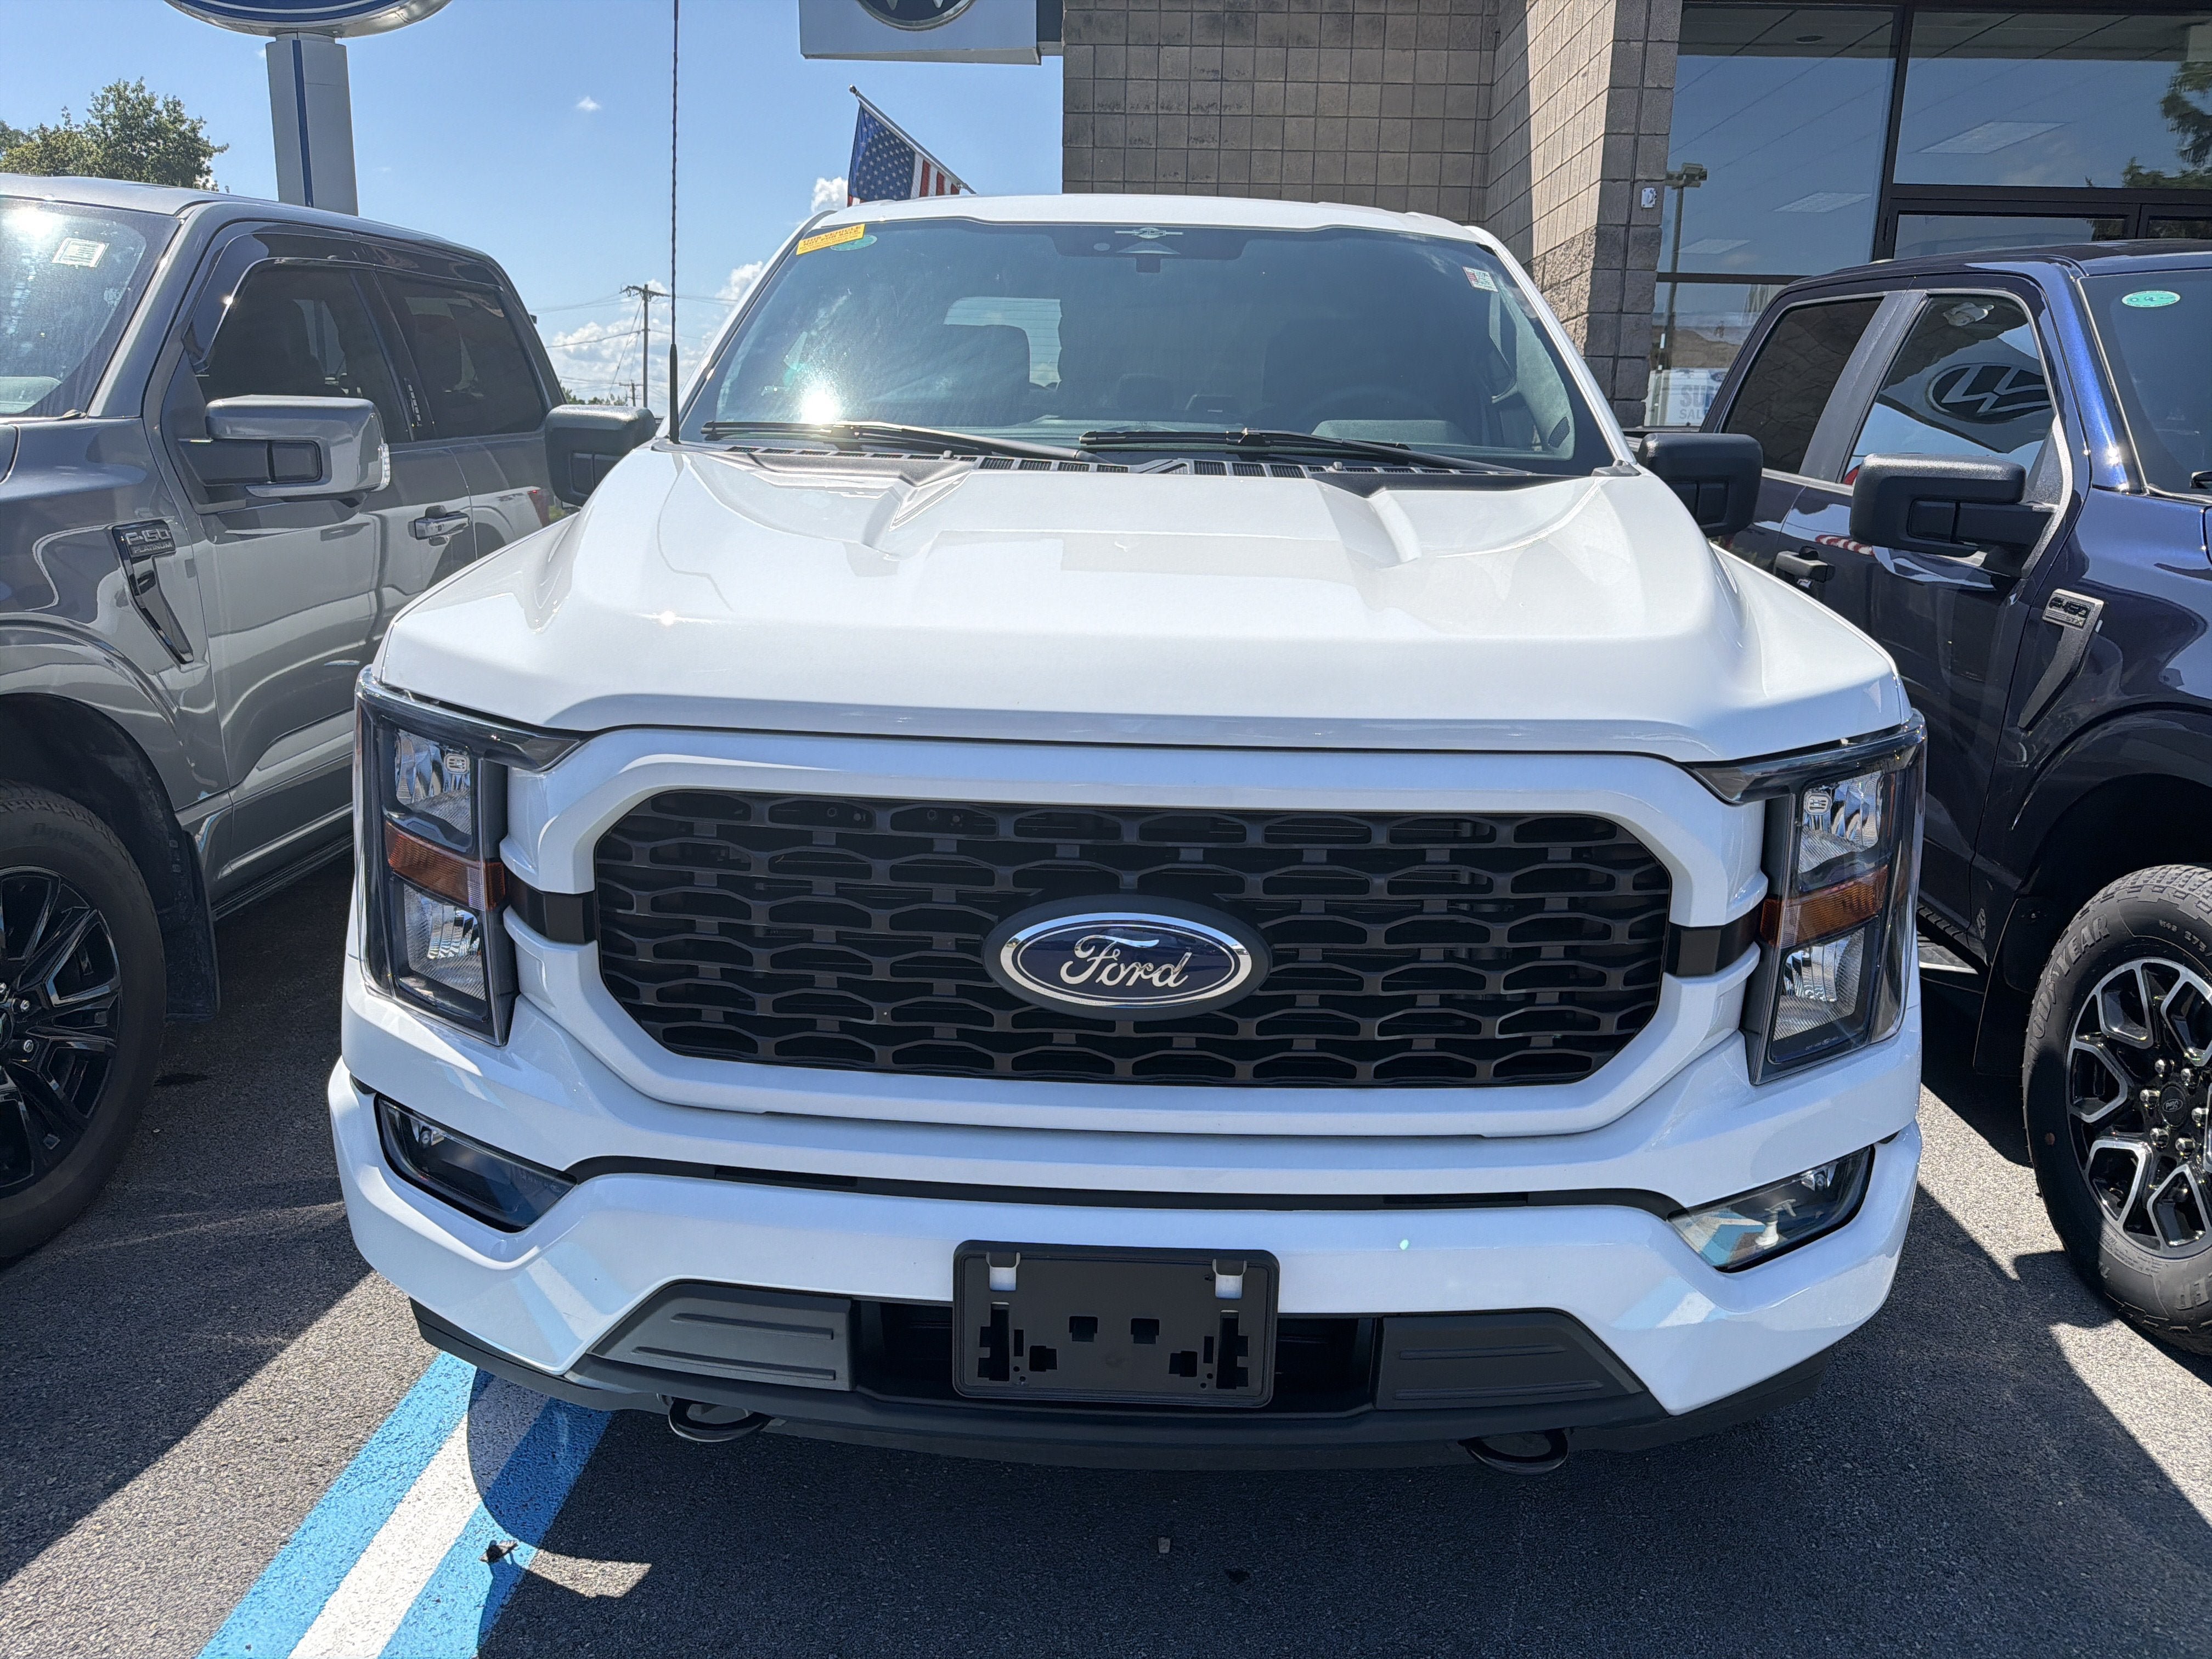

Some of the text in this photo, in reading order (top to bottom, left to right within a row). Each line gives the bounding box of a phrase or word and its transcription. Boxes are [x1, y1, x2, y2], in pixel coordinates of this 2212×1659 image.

[125, 529, 172, 545] F-150
[133, 541, 173, 554] PLATINUM
[2064, 615, 2085, 627] STX
[1060, 934, 1192, 988] Ford
